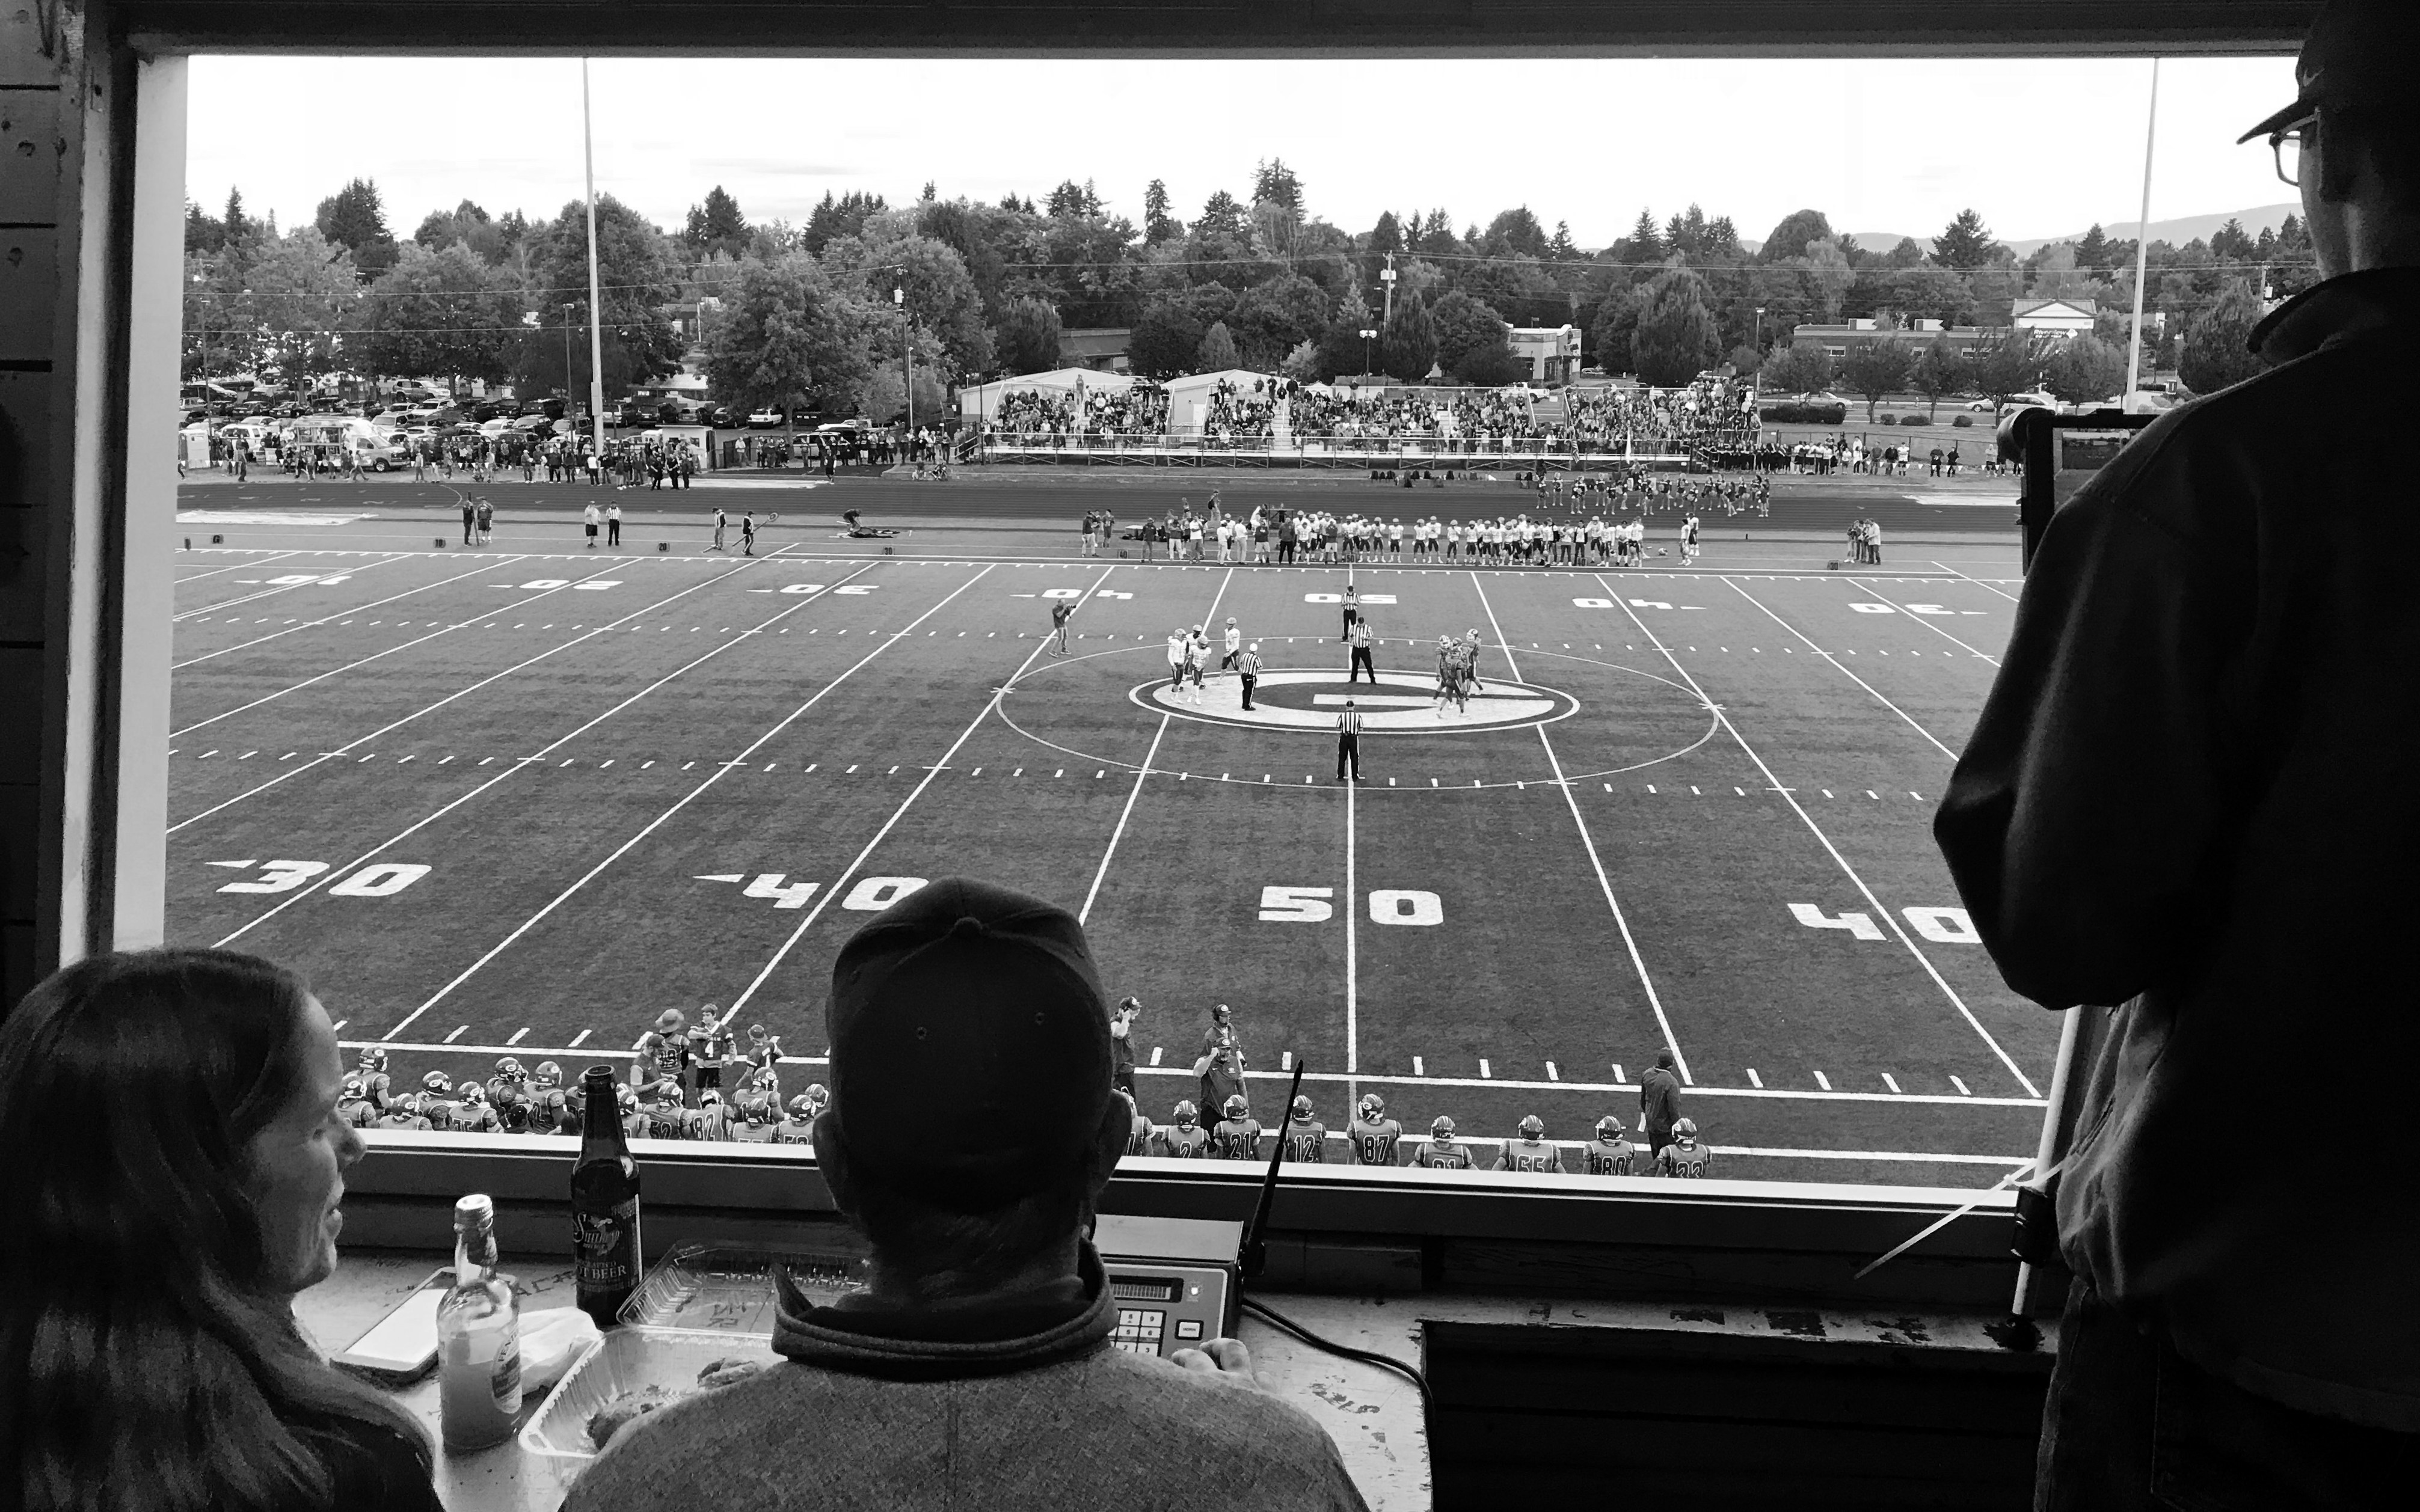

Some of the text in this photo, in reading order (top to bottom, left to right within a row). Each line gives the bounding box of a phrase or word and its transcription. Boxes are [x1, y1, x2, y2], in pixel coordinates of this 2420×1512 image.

[435, 539, 443, 548] 10
[659, 542, 667, 551] 20
[883, 546, 893, 556] 30
[215, 859, 432, 897] 30
[742, 874, 929, 911] 40
[1258, 886, 1445, 926] 50
[704, 1041, 714, 1058] 4
[693, 1112, 715, 1142] 82
[1230, 1131, 1251, 1160] 21
[1294, 1134, 1316, 1163] 12
[1363, 1134, 1390, 1163] 87
[592, 1264, 627, 1279] BEER
